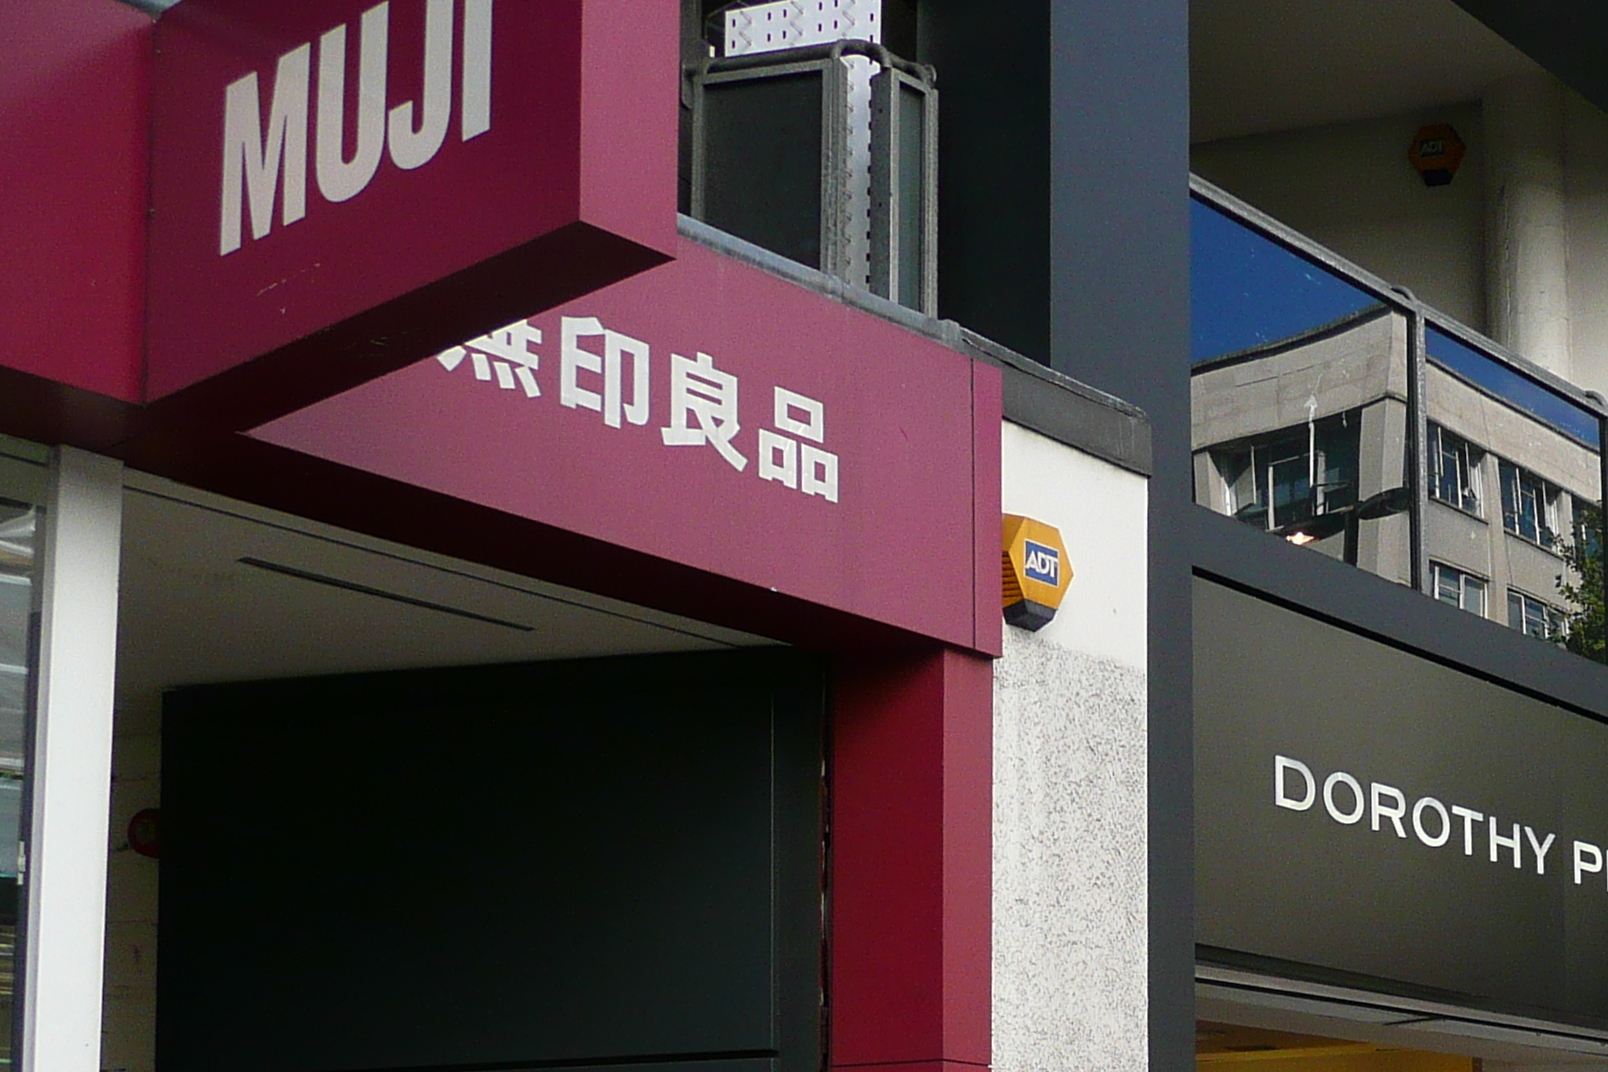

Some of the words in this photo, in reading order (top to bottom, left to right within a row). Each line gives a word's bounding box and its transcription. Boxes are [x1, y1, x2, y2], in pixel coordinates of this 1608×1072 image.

[219, 0, 493, 256] MUJI
[1025, 549, 1059, 579] ADT
[1273, 754, 1556, 875] DOROTHY
